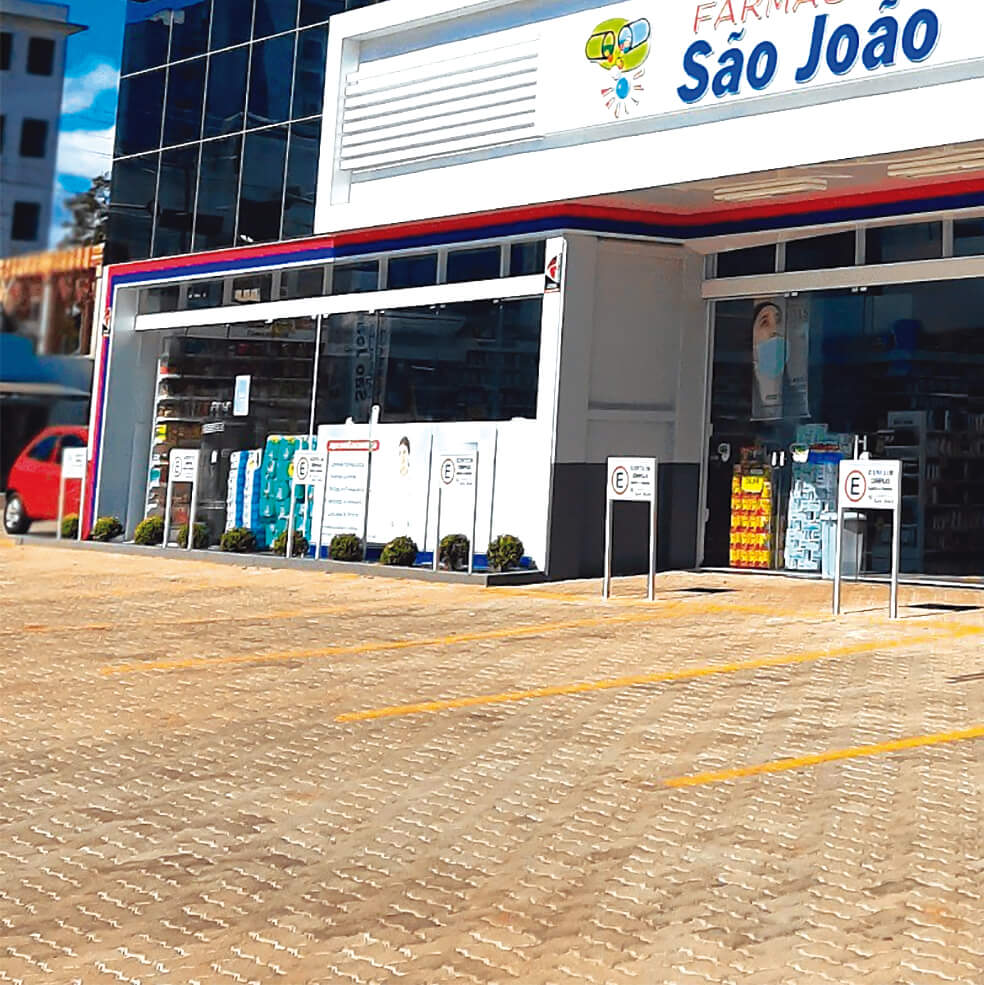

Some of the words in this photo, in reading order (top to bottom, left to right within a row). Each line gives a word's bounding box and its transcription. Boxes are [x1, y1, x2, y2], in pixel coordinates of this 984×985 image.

[677, 28, 778, 104] São
[616, 472, 624, 488] E
[850, 477, 860, 495] E
